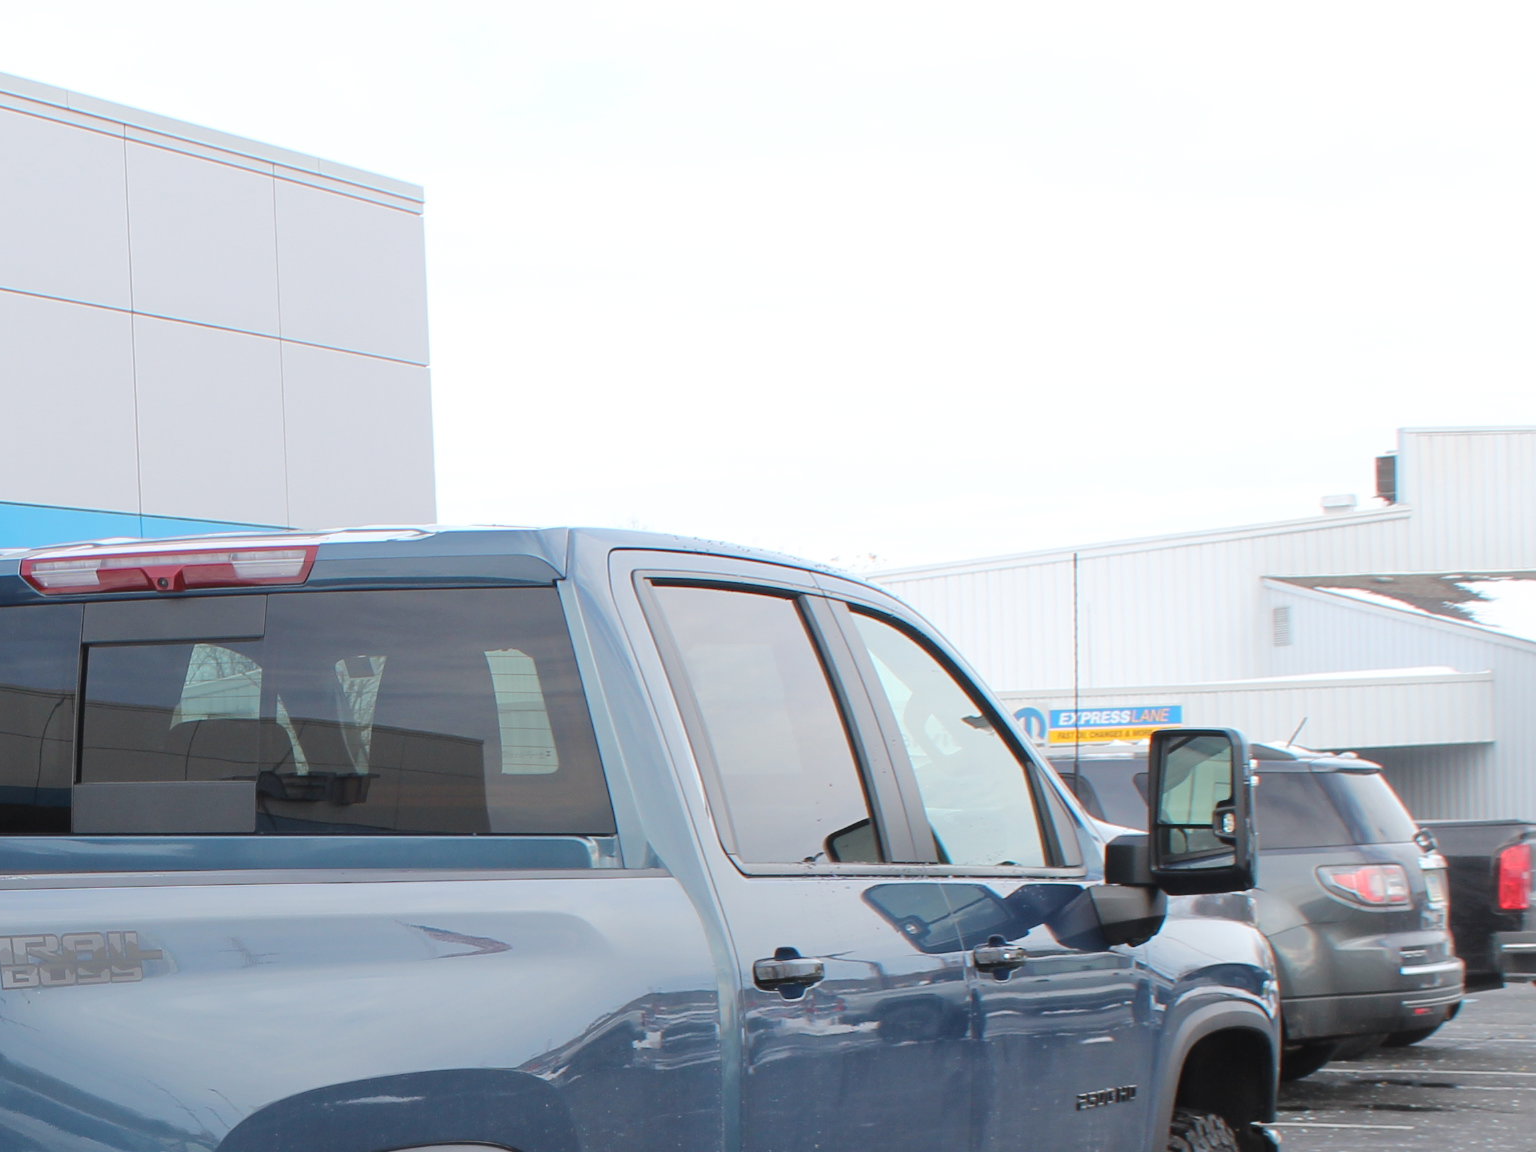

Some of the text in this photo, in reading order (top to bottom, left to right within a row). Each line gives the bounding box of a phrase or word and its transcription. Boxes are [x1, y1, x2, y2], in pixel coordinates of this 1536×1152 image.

[1089, 728, 1121, 739] CHANGES
[0, 962, 143, 990] BOSS
[1075, 1089, 1116, 1111] 2500
